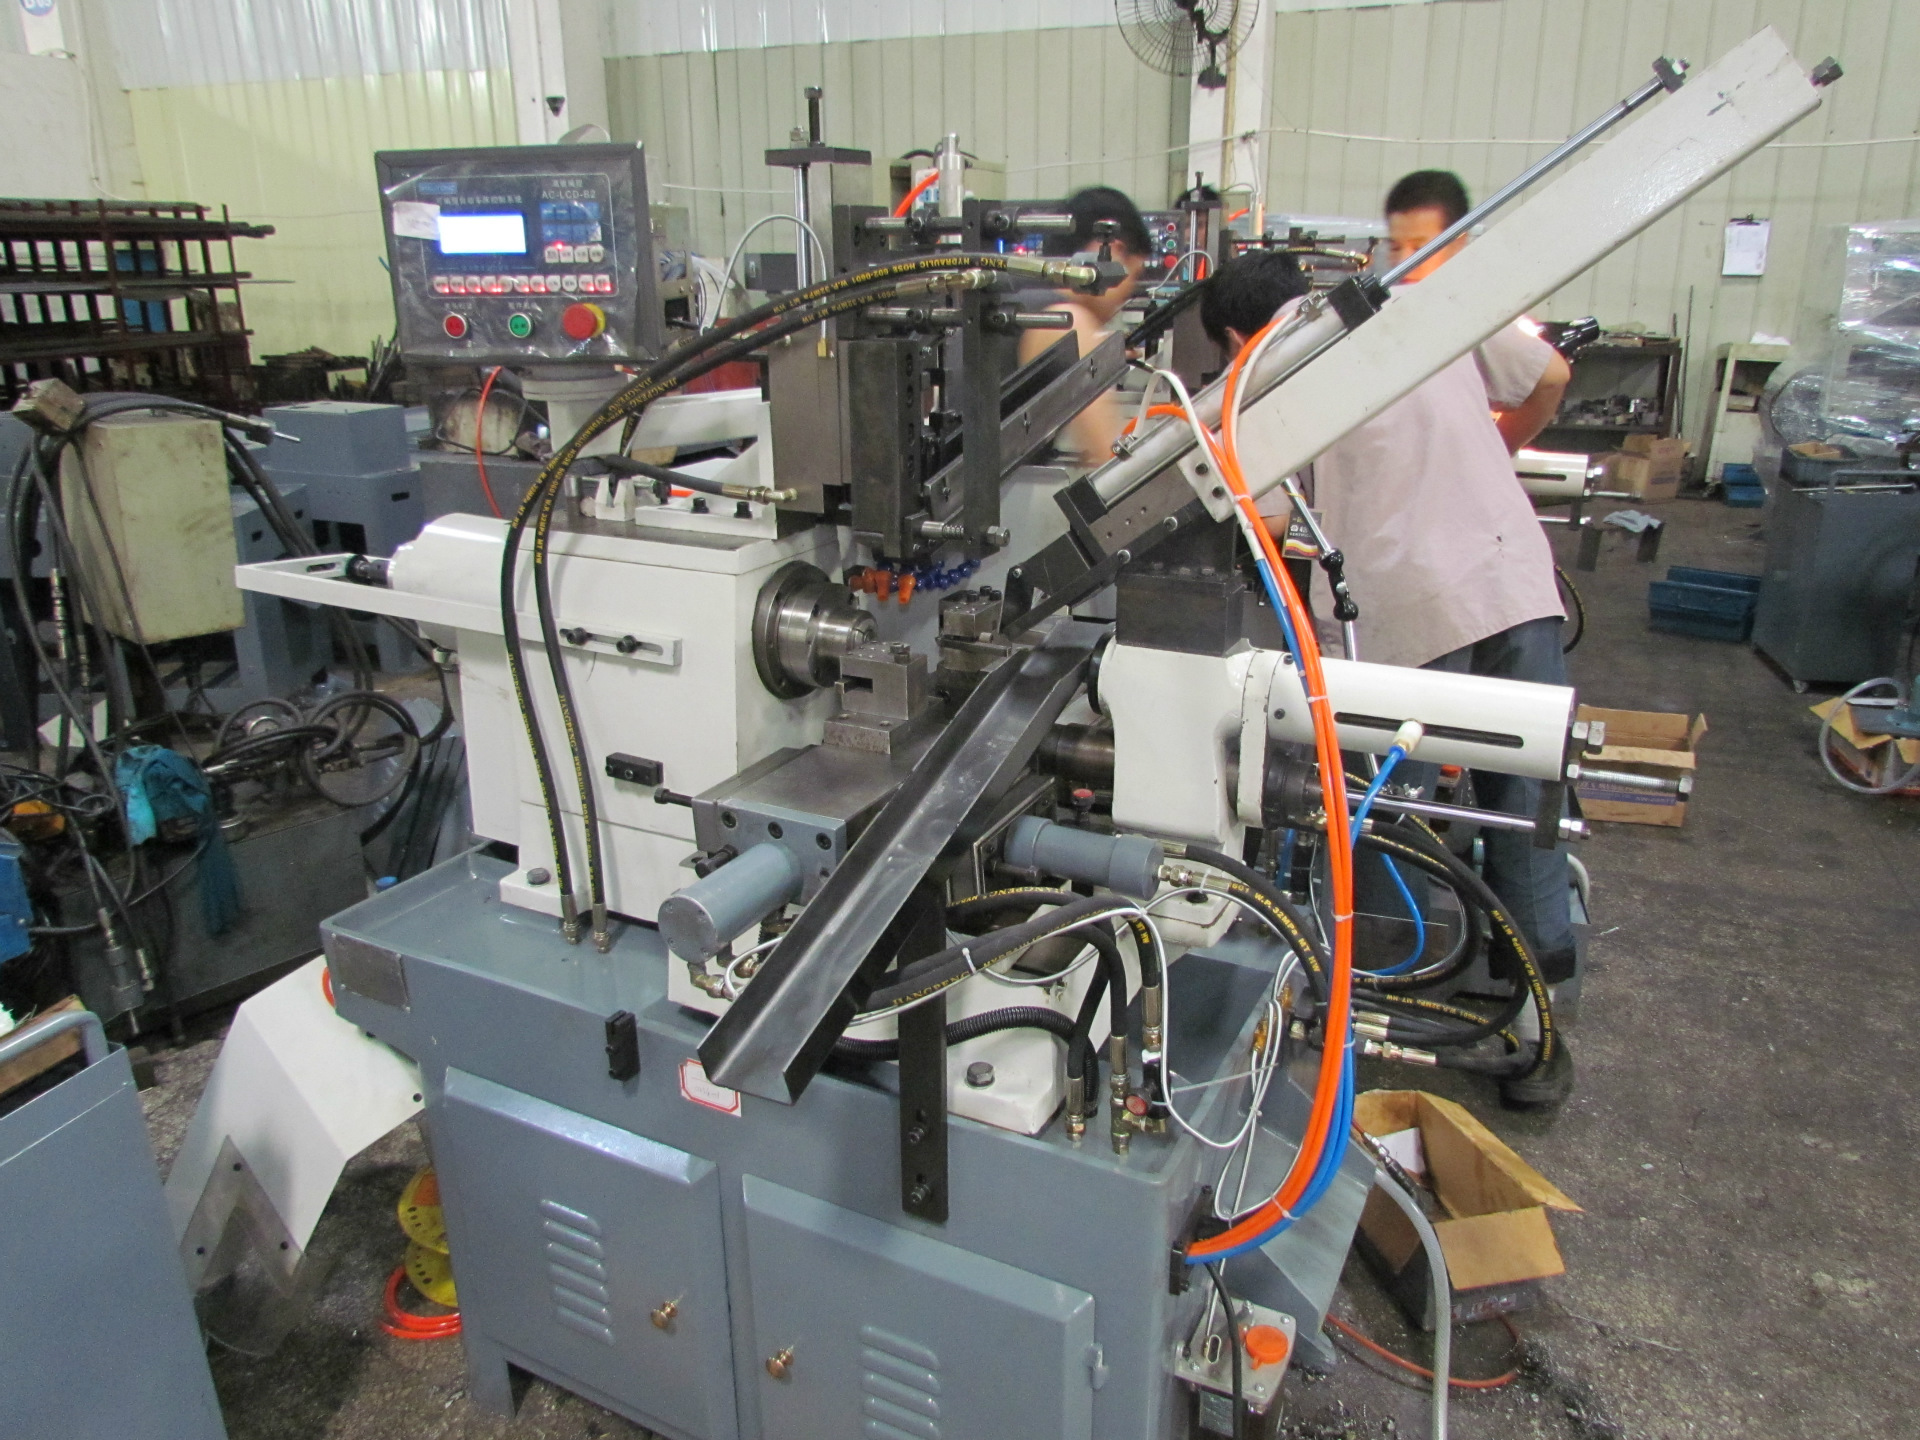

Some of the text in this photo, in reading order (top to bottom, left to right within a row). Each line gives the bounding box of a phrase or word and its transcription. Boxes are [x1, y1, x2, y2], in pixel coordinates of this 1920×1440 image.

[892, 262, 916, 273] HOSE
[920, 257, 970, 268] HYDRAULIC
[1272, 906, 1299, 936] 32MPa
[1297, 937, 1312, 952] MT
[1308, 955, 1321, 973] HW
